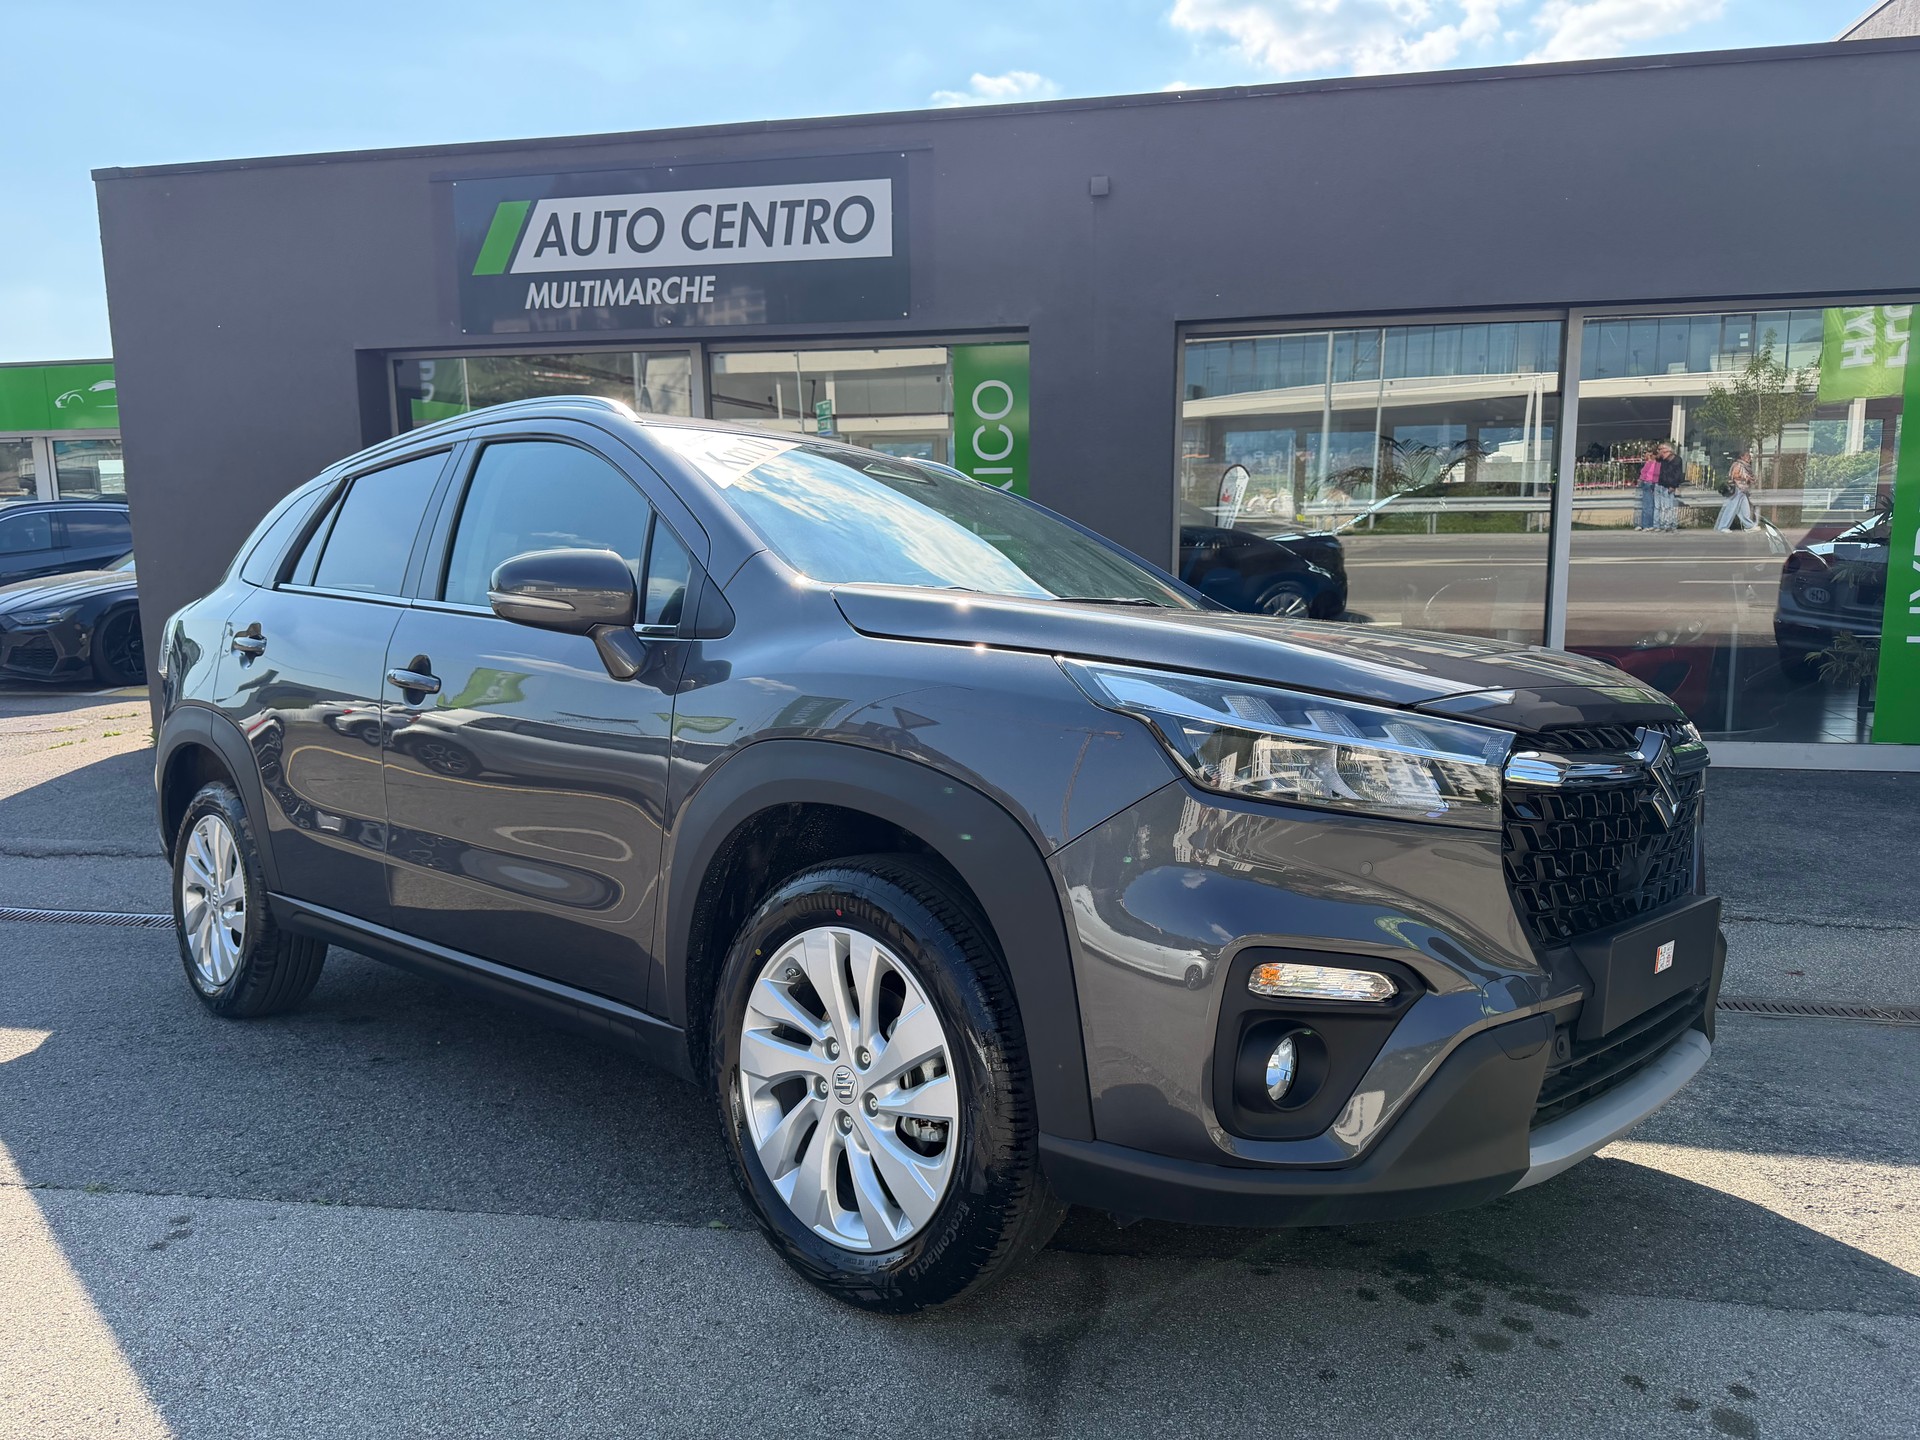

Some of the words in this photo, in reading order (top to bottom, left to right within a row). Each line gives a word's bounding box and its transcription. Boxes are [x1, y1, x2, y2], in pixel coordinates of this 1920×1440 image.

[533, 207, 665, 258] AUTO
[681, 195, 875, 251] CENTRO
[525, 275, 716, 309] MULTIMARCHE
[972, 379, 1014, 490] ICO
